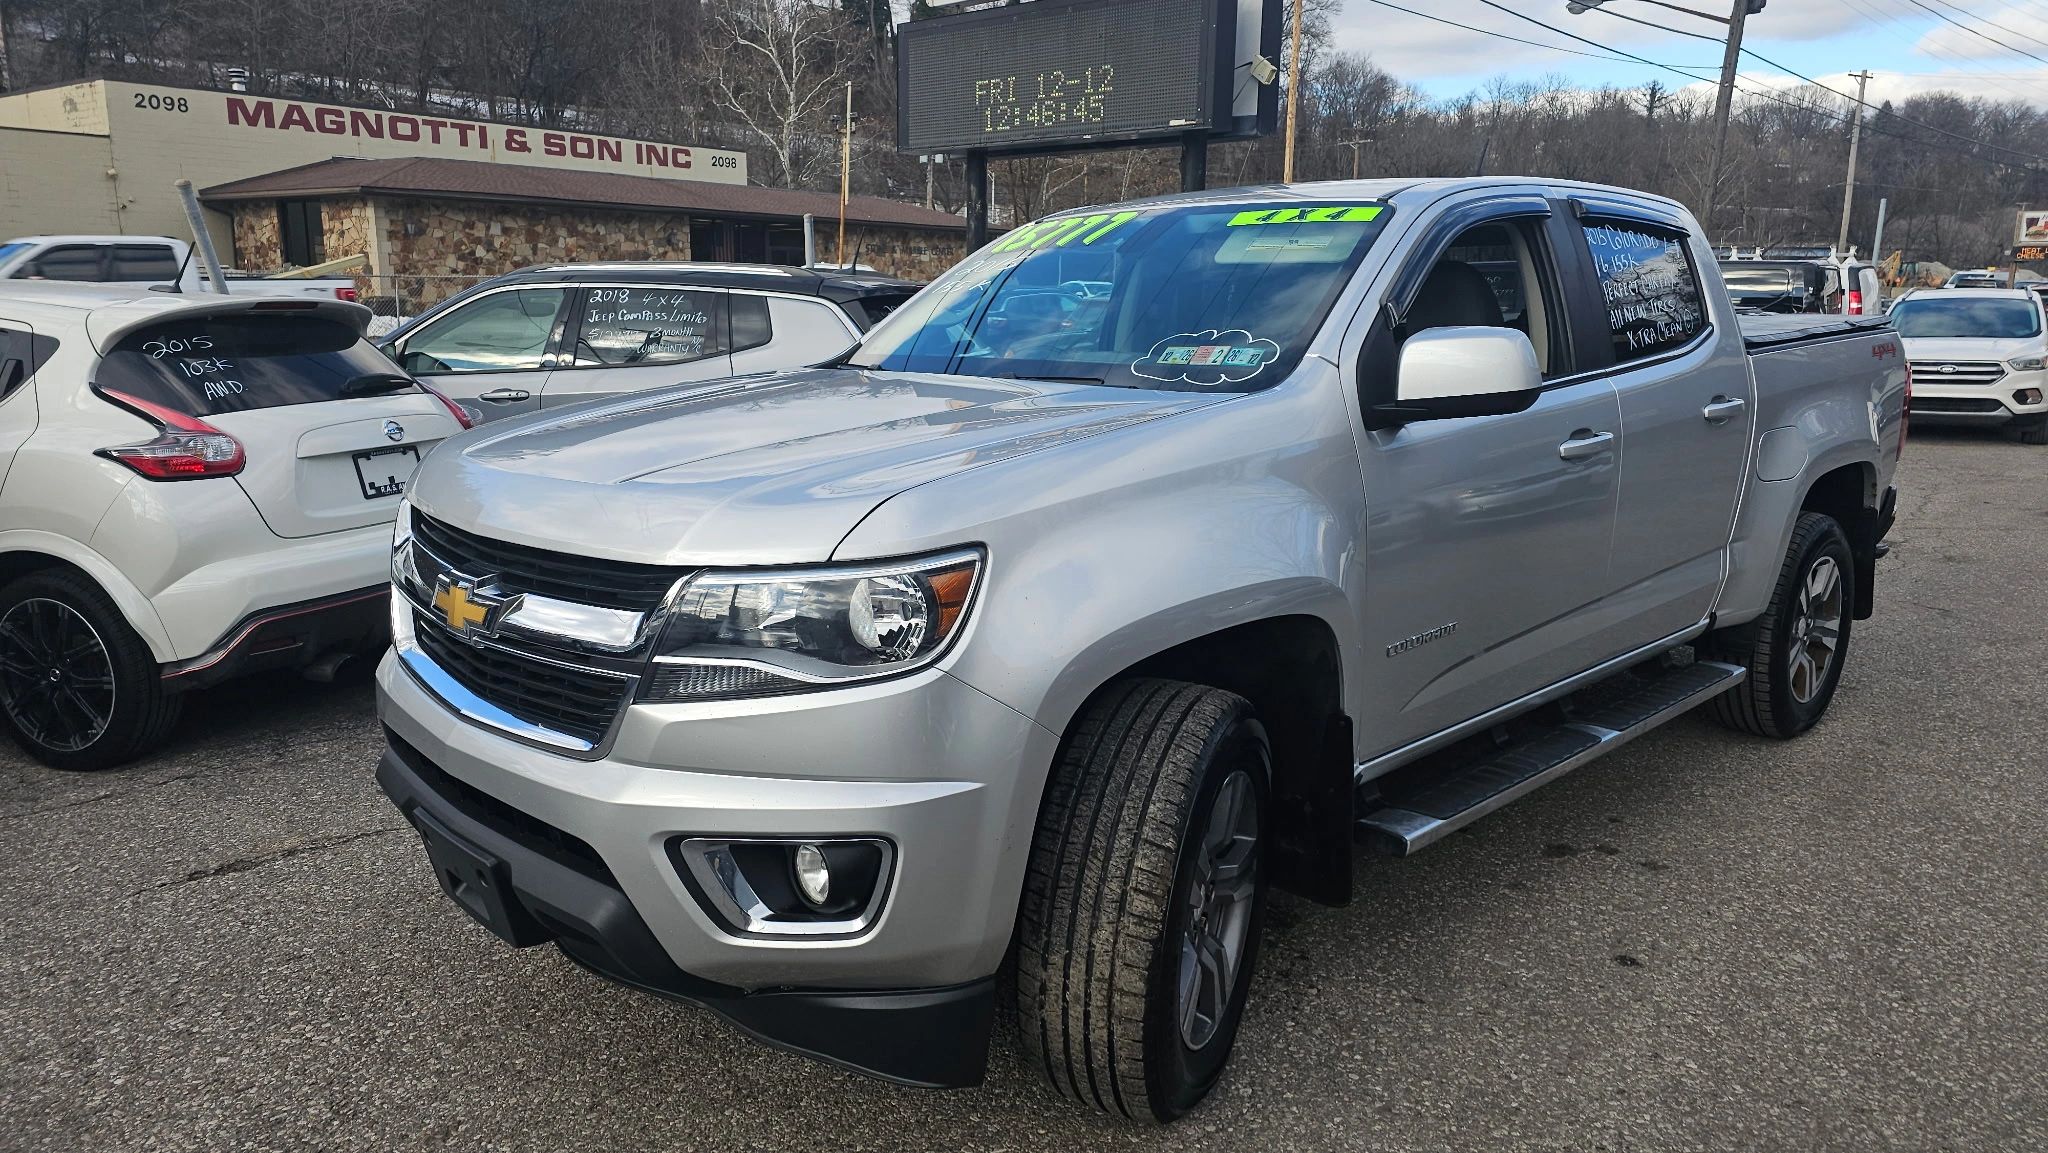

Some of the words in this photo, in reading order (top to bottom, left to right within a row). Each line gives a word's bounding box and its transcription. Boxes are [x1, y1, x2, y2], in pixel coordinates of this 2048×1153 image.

[975, 76, 1017, 105] FRI
[1037, 64, 1115, 98] 12-12
[133, 92, 190, 113] 2098
[985, 94, 1105, 132] 12:46:45
[226, 97, 489, 150] MAGNOTTI
[504, 128, 533, 154] &
[543, 132, 623, 163] SON
[635, 143, 692, 170] INC
[710, 155, 738, 169] 2098
[589, 288, 630, 303] 2018
[587, 308, 615, 323] JEEP
[142, 335, 214, 359] 2015
[1211, 349, 1224, 364] 2
[179, 356, 234, 378] 103K
[1386, 621, 1458, 658] COLORADO
